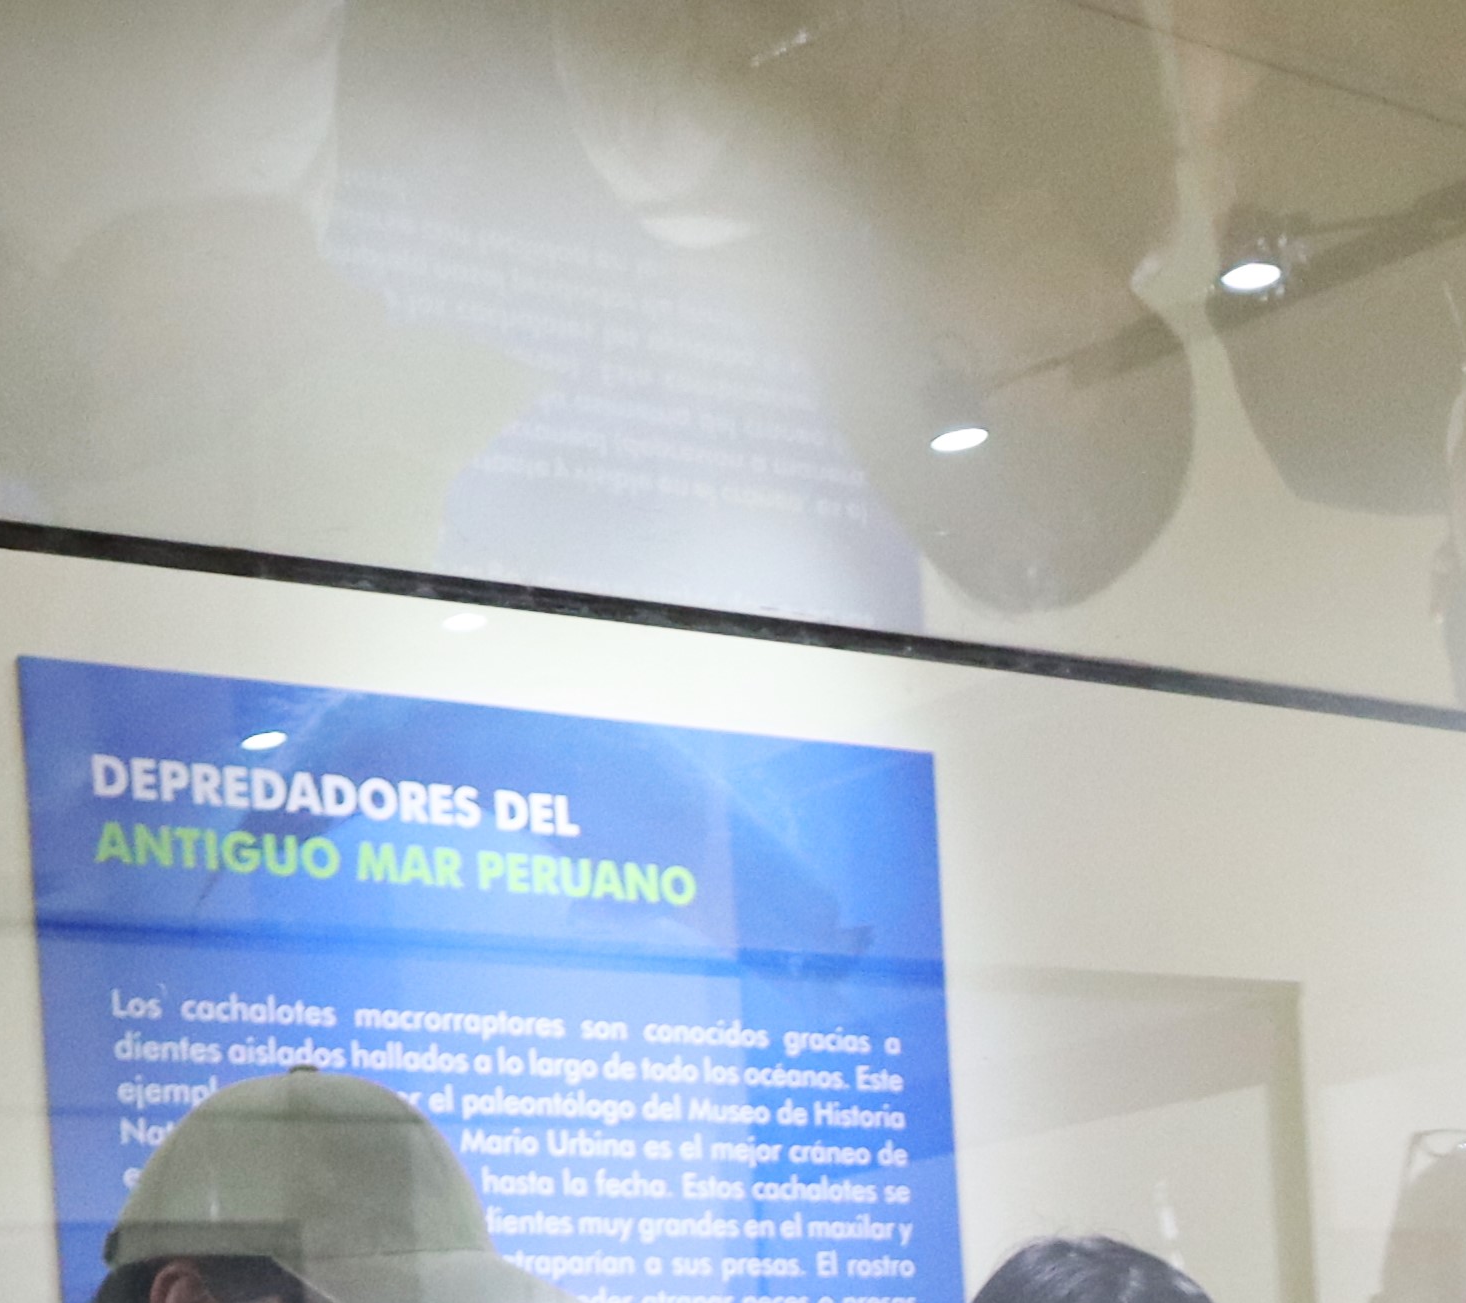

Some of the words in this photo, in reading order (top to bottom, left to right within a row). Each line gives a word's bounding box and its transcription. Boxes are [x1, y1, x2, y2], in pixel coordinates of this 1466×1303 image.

[92, 753, 481, 828] DEPREDADORES
[494, 789, 581, 838] DEL
[94, 821, 340, 879] ANTIGUO
[357, 841, 463, 888] MAR
[477, 850, 696, 907] PERUANO
[111, 989, 162, 1019] Los
[181, 992, 337, 1028] cachalotes
[354, 1008, 566, 1041] macrorraptores
[581, 1019, 628, 1040] son
[643, 1019, 769, 1048] conocidos
[784, 1027, 871, 1057] gracias
[885, 1036, 901, 1054] a
[114, 1031, 222, 1063] dientes
[228, 1036, 346, 1068] aislados
[351, 1040, 469, 1073] hallados
[474, 1054, 492, 1074] a
[497, 1047, 524, 1076] lo
[529, 1048, 598, 1085] largo
[603, 1051, 636, 1080] de
[641, 1055, 699, 1083] todo
[704, 1056, 740, 1085] los
[744, 1063, 850, 1090] océanos.
[855, 1065, 903, 1092] Este
[429, 1083, 454, 1113] el
[462, 1086, 635, 1126] paleontólogo
[642, 1092, 681, 1121] del
[688, 1099, 771, 1124] Museo
[777, 1098, 808, 1126] de
[814, 1101, 905, 1129] Historia
[460, 1127, 539, 1155] Mario
[547, 1128, 635, 1158] Urbina
[643, 1139, 673, 1160] es
[680, 1133, 702, 1161] el
[711, 1135, 781, 1168] mejor
[788, 1140, 871, 1165] cráneo
[878, 1140, 908, 1166] de
[482, 1166, 555, 1196] hasta
[562, 1167, 588, 1196] la
[595, 1168, 673, 1198] fecha.
[682, 1172, 745, 1199] Estos
[752, 1174, 878, 1202] cachalotes
[884, 1185, 911, 1204] se
[578, 1217, 632, 1243] muy
[638, 1211, 739, 1243] grandes
[744, 1218, 775, 1238] en
[780, 1212, 802, 1239] el
[808, 1214, 894, 1240] maxilar
[898, 1223, 913, 1246] y
[644, 1256, 663, 1275] a
[672, 1257, 713, 1276] sus
[722, 1257, 806, 1282] presas.
[816, 1250, 838, 1278] El
[847, 1255, 916, 1278] rostro
